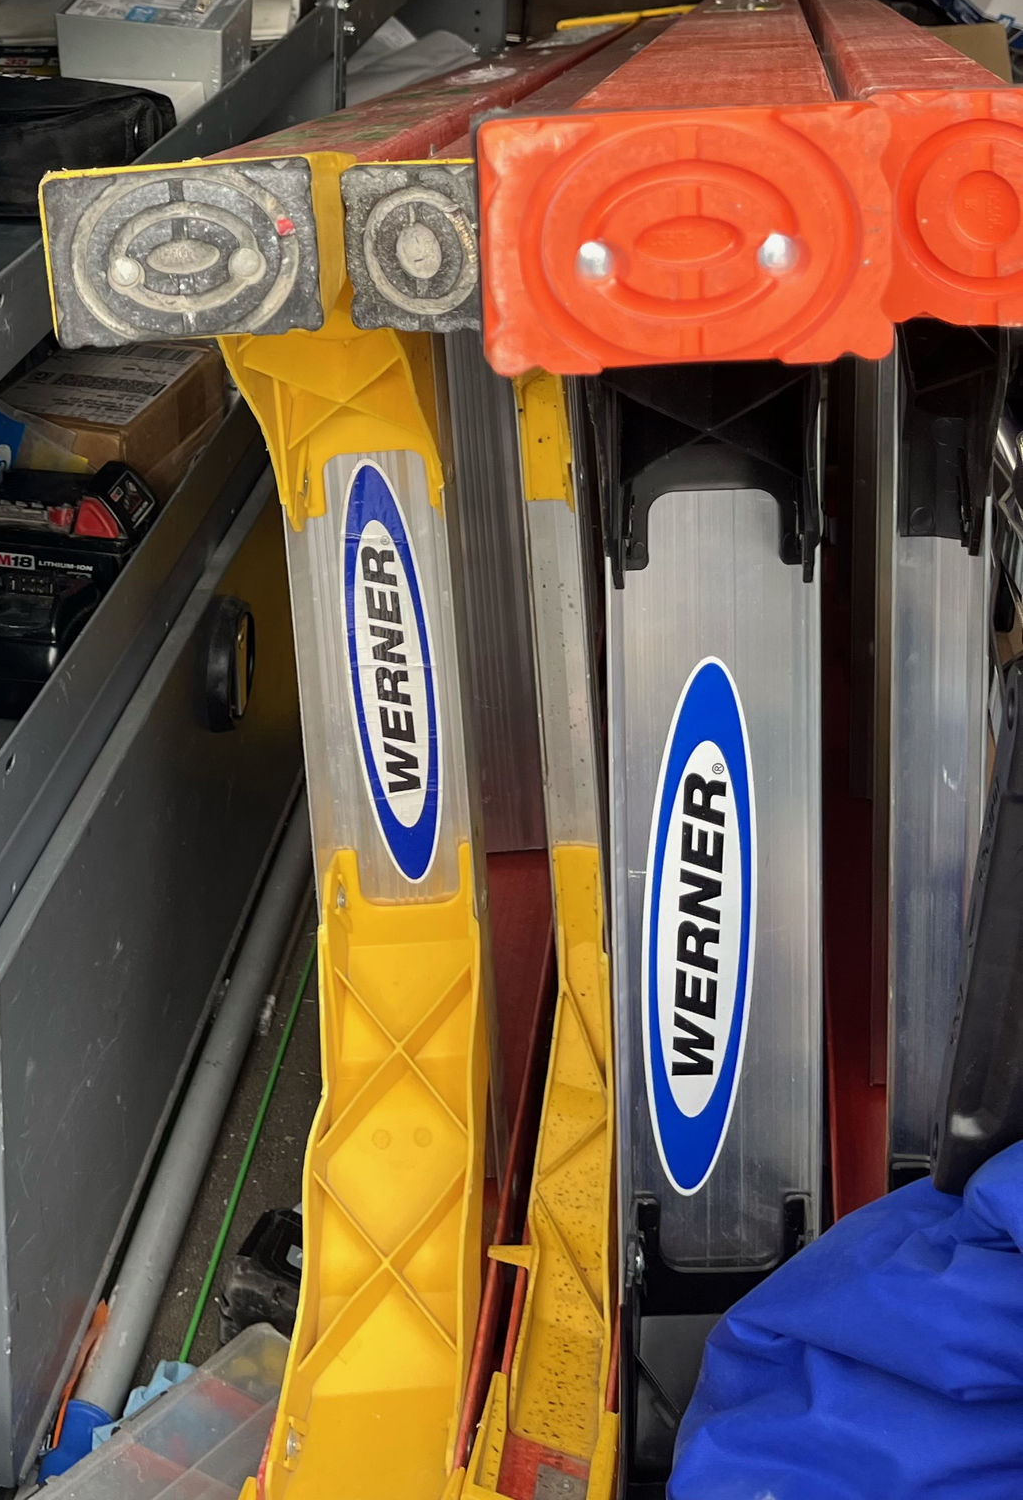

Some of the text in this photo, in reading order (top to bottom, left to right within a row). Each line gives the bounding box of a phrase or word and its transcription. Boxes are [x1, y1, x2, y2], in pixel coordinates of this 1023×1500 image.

[38, 560, 93, 572] LITHIUM-ION
[362, 544, 422, 794] WERNER
[671, 772, 727, 1077] WERNER
